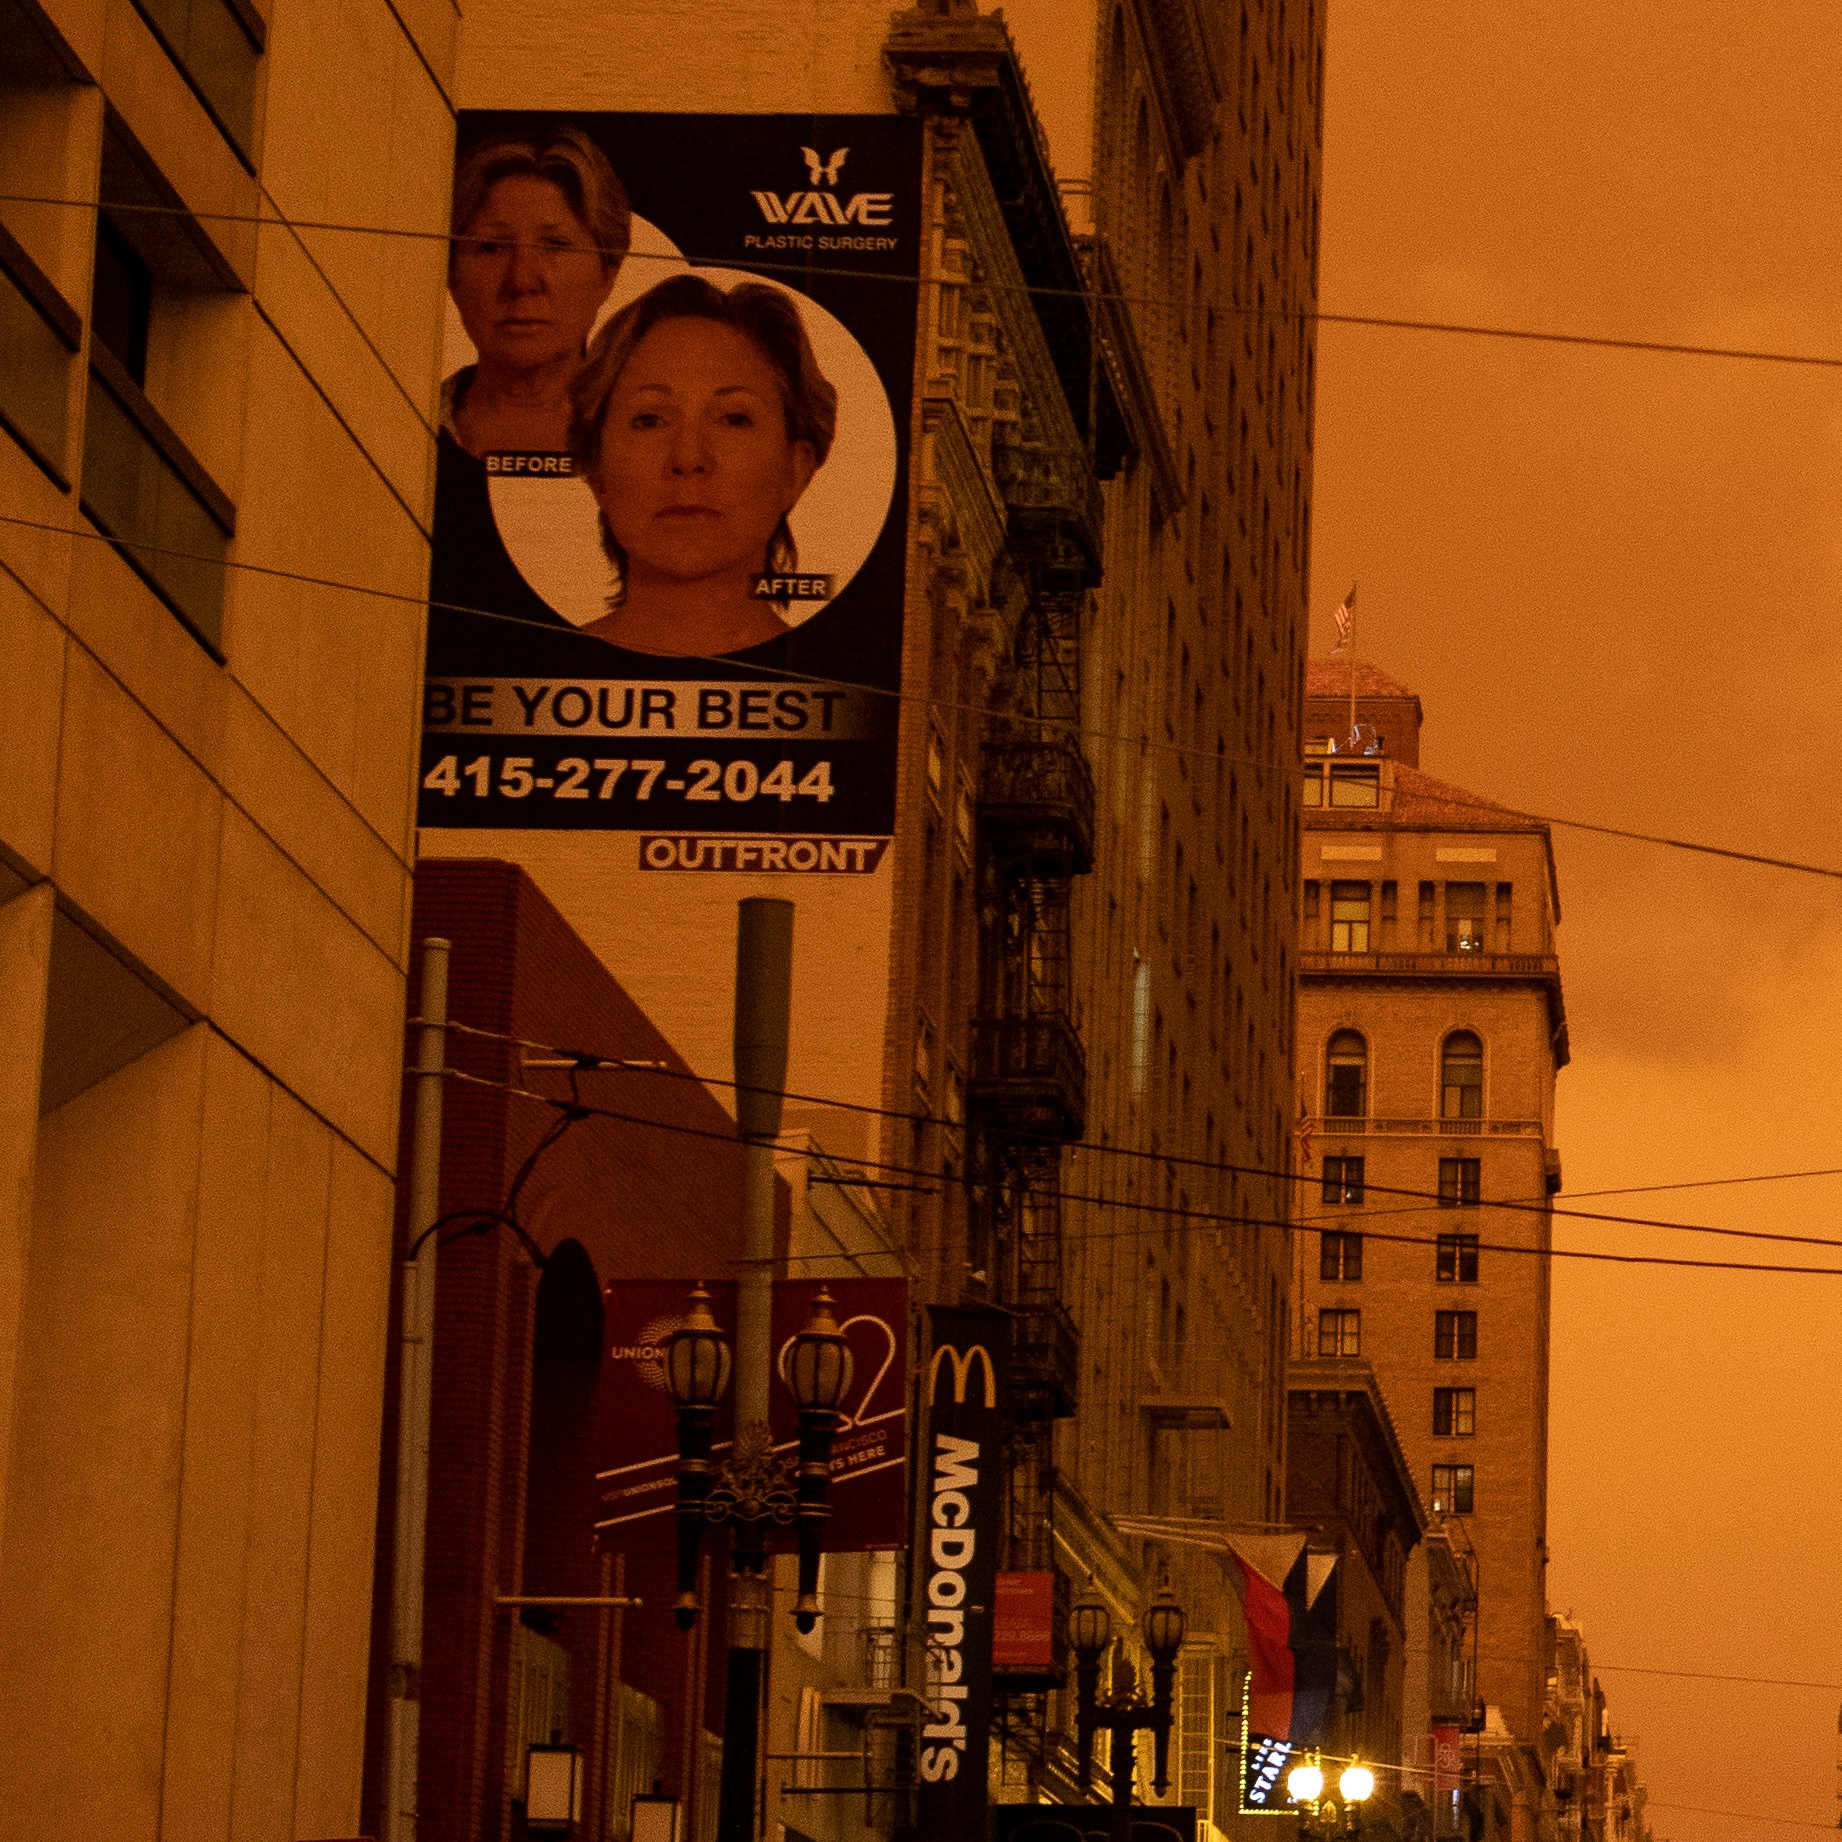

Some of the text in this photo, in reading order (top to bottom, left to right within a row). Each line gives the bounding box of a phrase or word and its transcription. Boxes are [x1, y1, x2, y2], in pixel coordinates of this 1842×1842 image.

[749, 189, 896, 227] WAVE
[743, 234, 899, 252] PLASTIC SURGERY
[485, 455, 572, 474] BEFORE
[754, 579, 827, 597] AFTER
[423, 684, 846, 733] BE YOUR BEST
[422, 754, 836, 803] 415-277-2044
[645, 839, 879, 872] OUTFRONT
[611, 1345, 664, 1361] UNION
[922, 1433, 982, 1784] McDonald's
